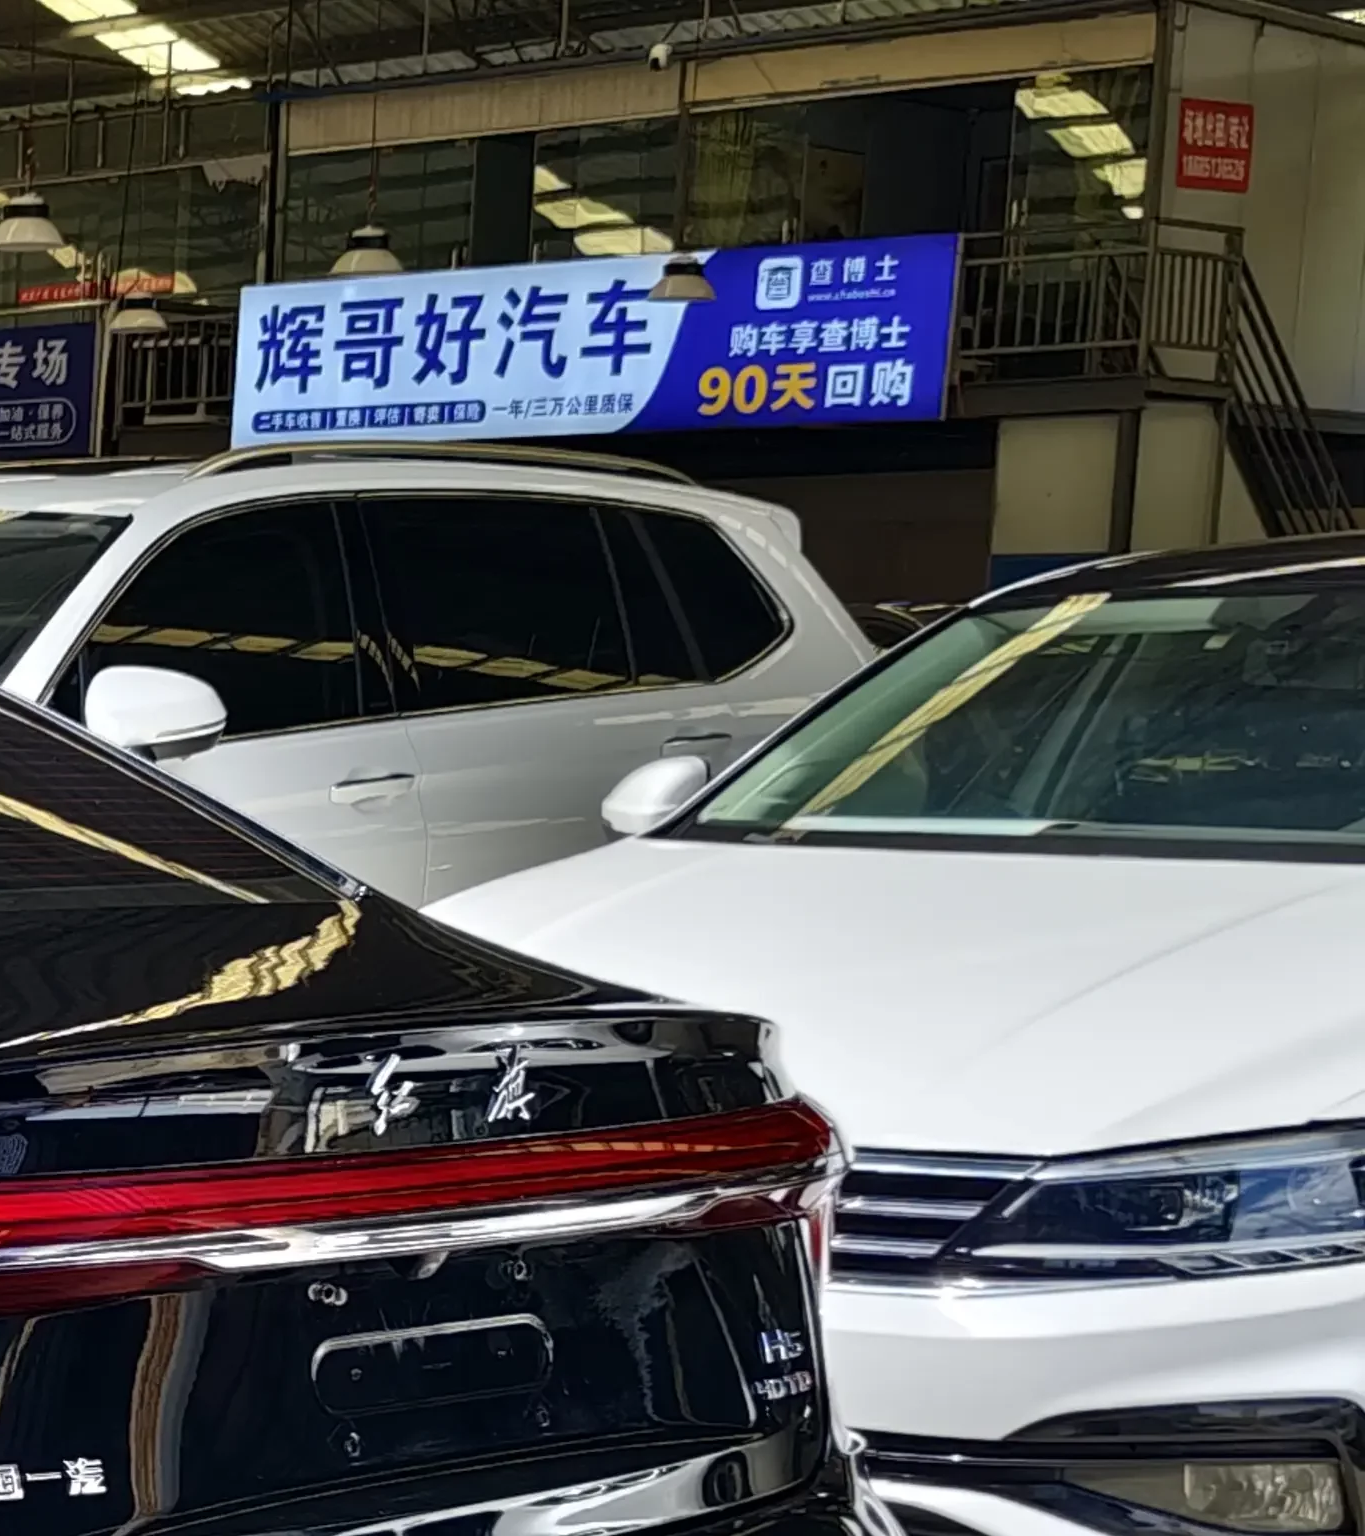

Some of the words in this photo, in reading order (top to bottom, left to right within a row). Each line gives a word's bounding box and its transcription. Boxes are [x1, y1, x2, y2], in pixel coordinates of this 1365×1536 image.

[809, 254, 899, 285] 查博士
[254, 279, 652, 393] 辉哥好汽车
[728, 315, 912, 358] 购车享查博士
[492, 393, 633, 418] 一年/三万公里质保
[760, 1329, 805, 1364] H5
